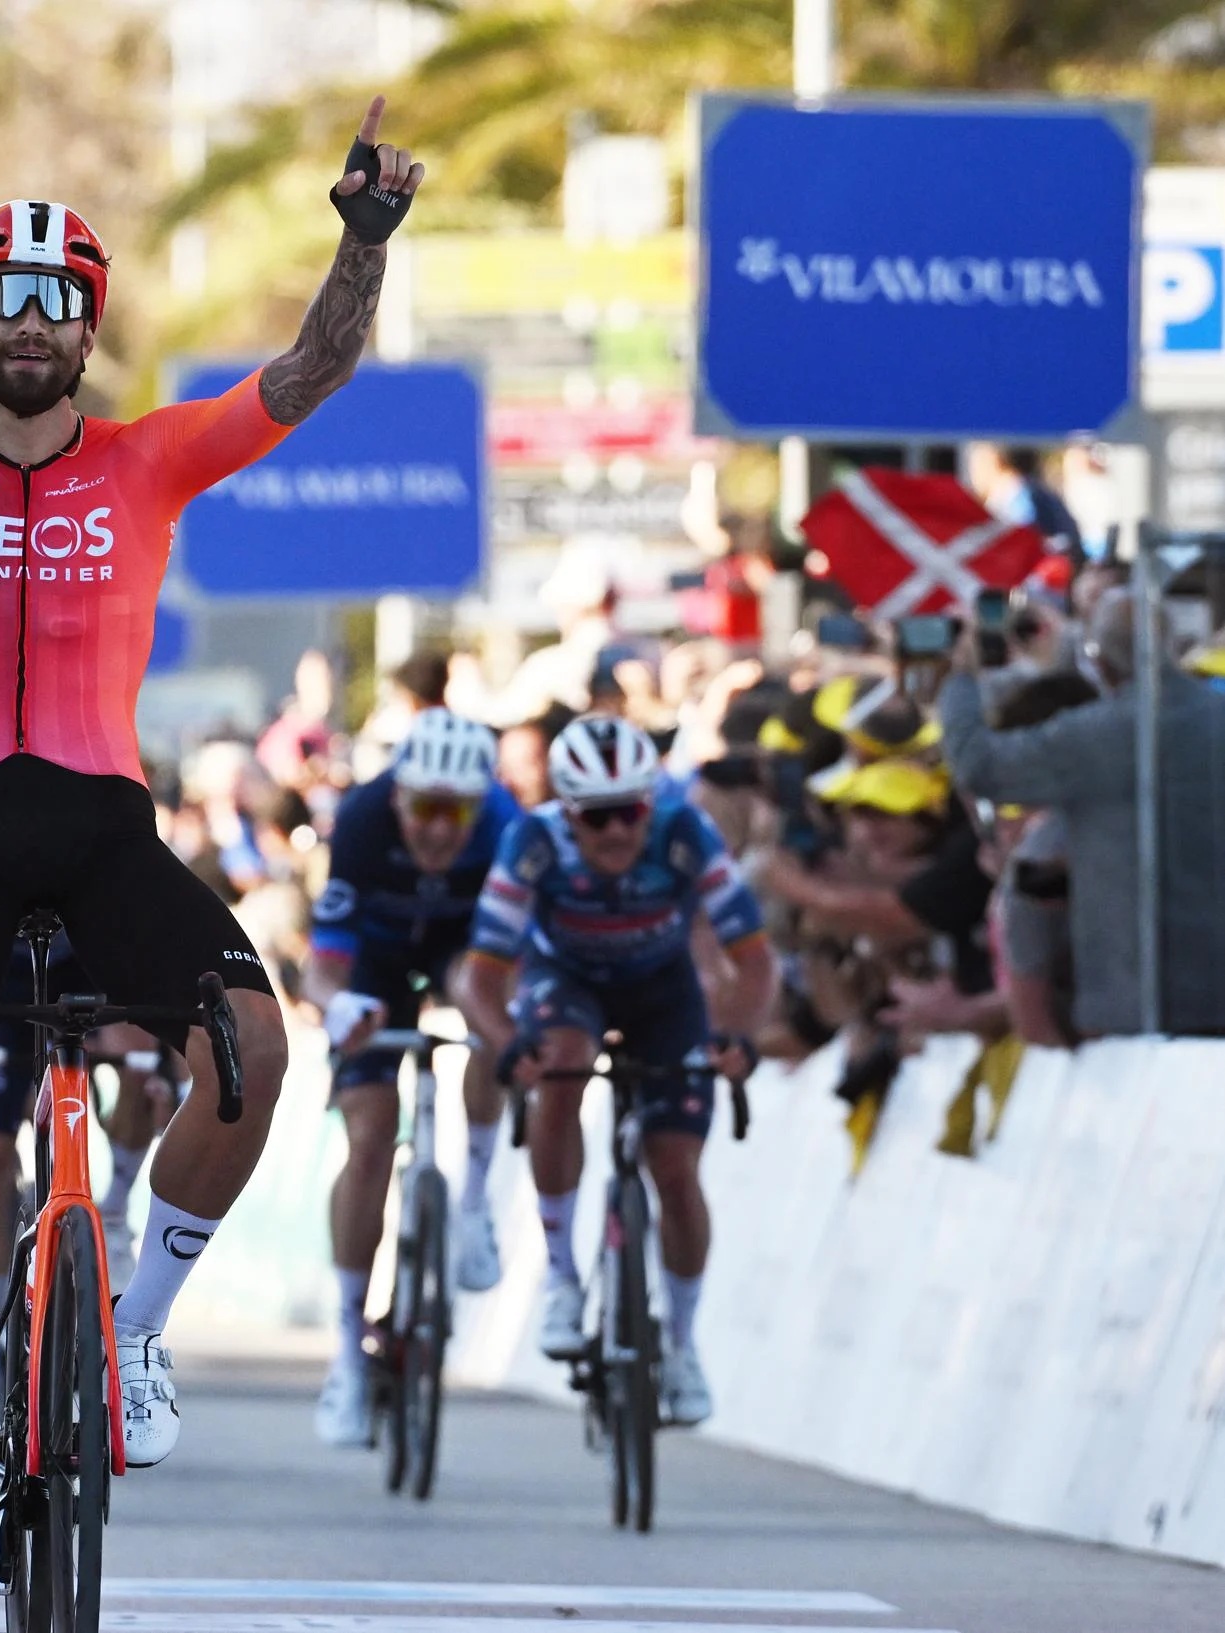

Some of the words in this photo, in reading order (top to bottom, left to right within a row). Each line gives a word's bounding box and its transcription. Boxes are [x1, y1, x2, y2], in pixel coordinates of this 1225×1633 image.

[369, 184, 399, 208] GOBIK
[779, 252, 1104, 307] VILAMOURA
[45, 476, 105, 497] PINARELLO
